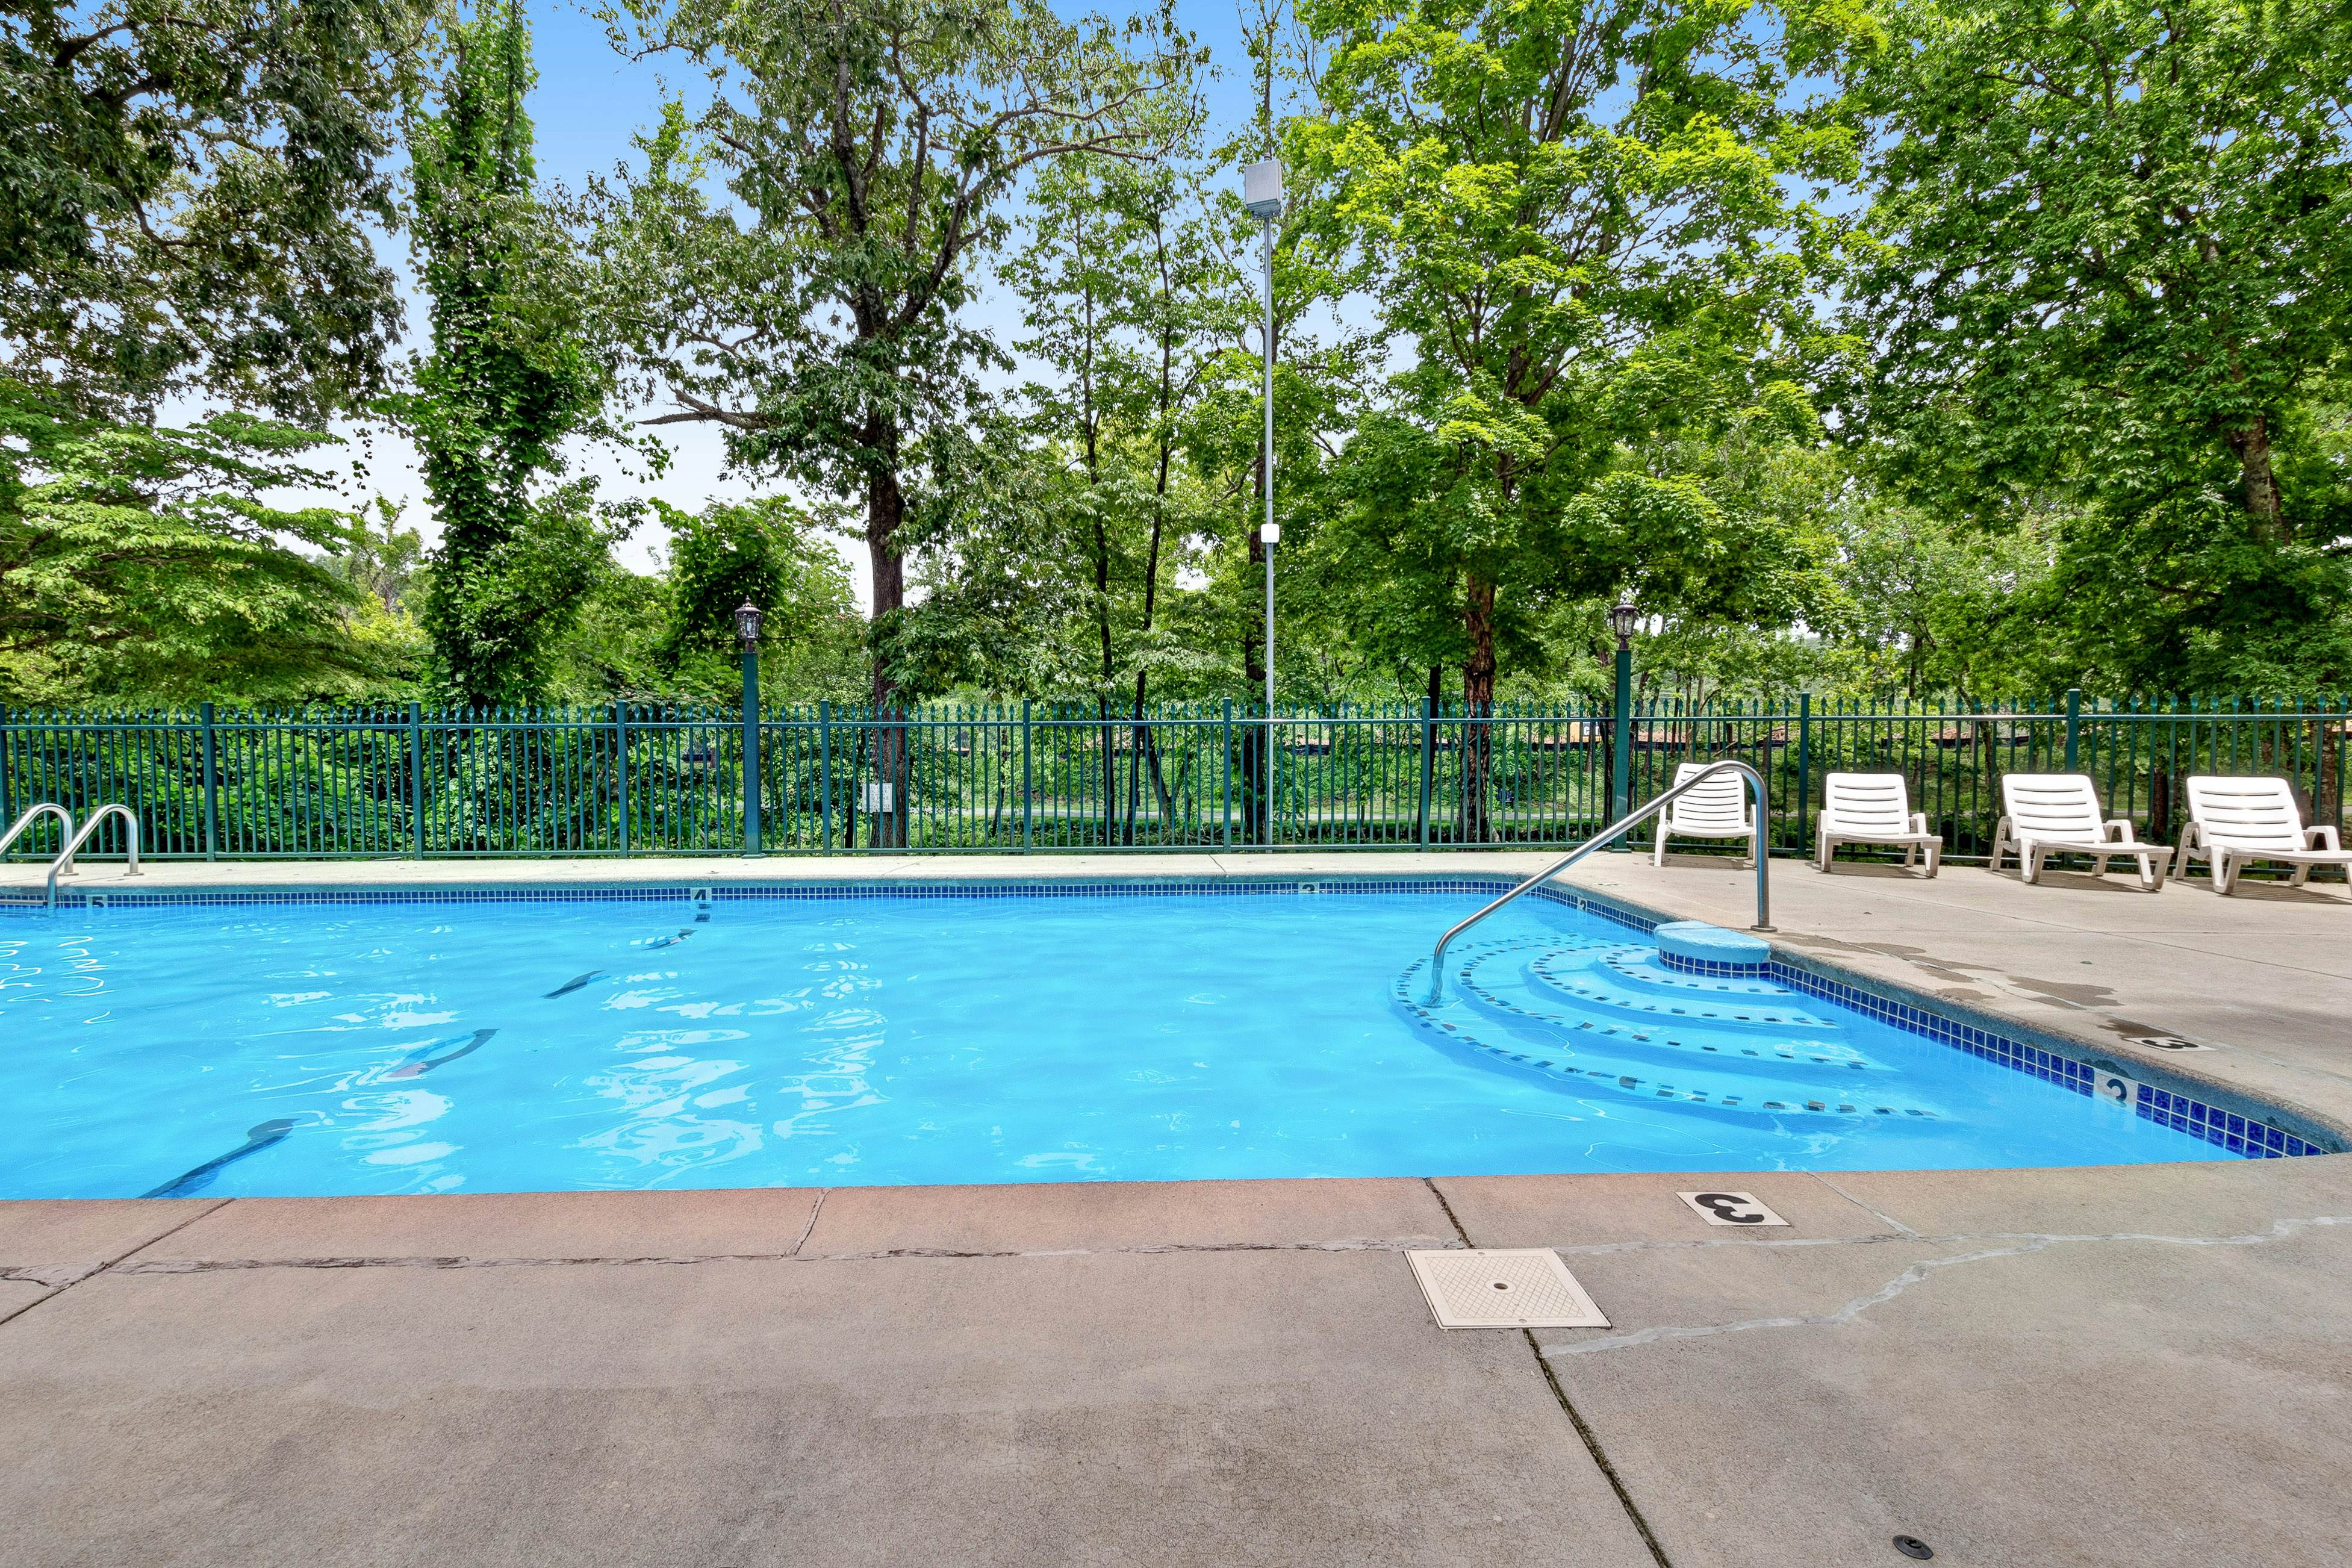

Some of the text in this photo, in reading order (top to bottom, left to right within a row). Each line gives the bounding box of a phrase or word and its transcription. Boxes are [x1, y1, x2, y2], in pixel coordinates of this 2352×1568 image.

[92, 896, 105, 908] 5
[2142, 1039, 2199, 1050] 3
[1694, 1193, 1765, 1224] 3
